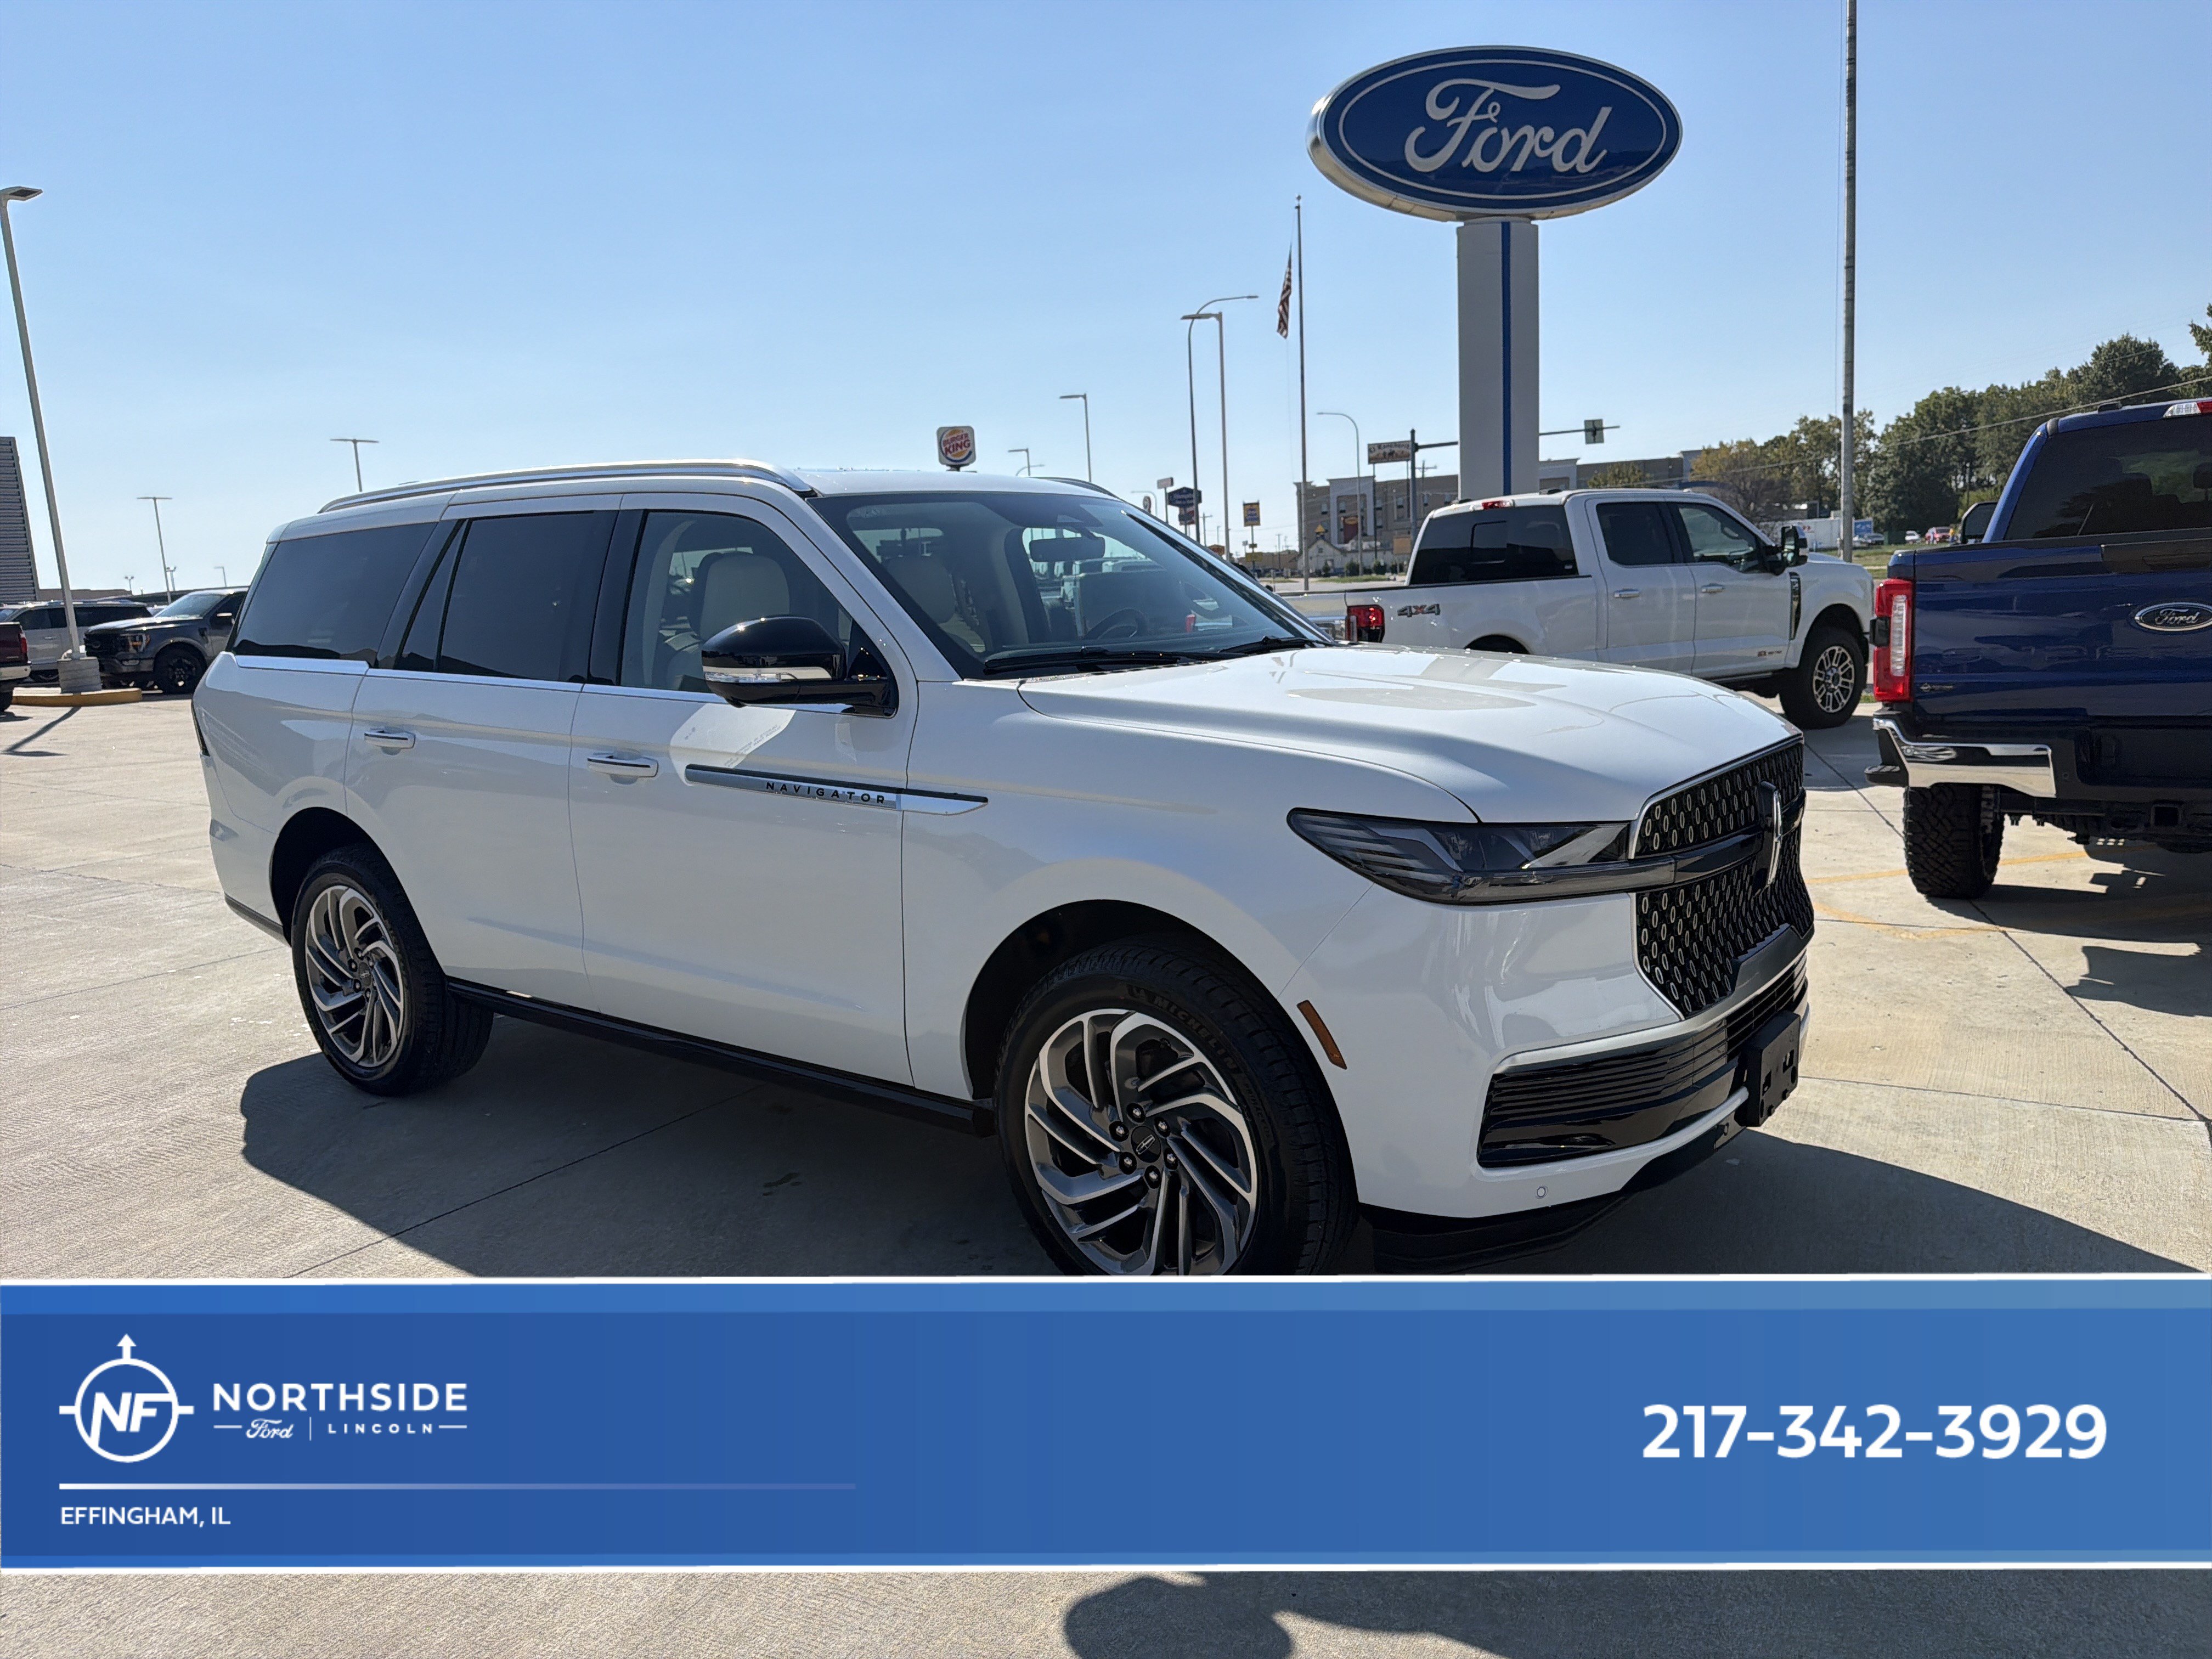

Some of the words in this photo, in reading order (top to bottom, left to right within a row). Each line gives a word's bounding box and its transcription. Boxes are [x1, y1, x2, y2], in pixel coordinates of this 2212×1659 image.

[1404, 78, 1612, 173] Ford
[945, 439, 970, 456] KING
[2154, 608, 2200, 625] Ford
[766, 781, 885, 804] NAVIGATOR
[1153, 996, 1238, 1070] MICHELIN
